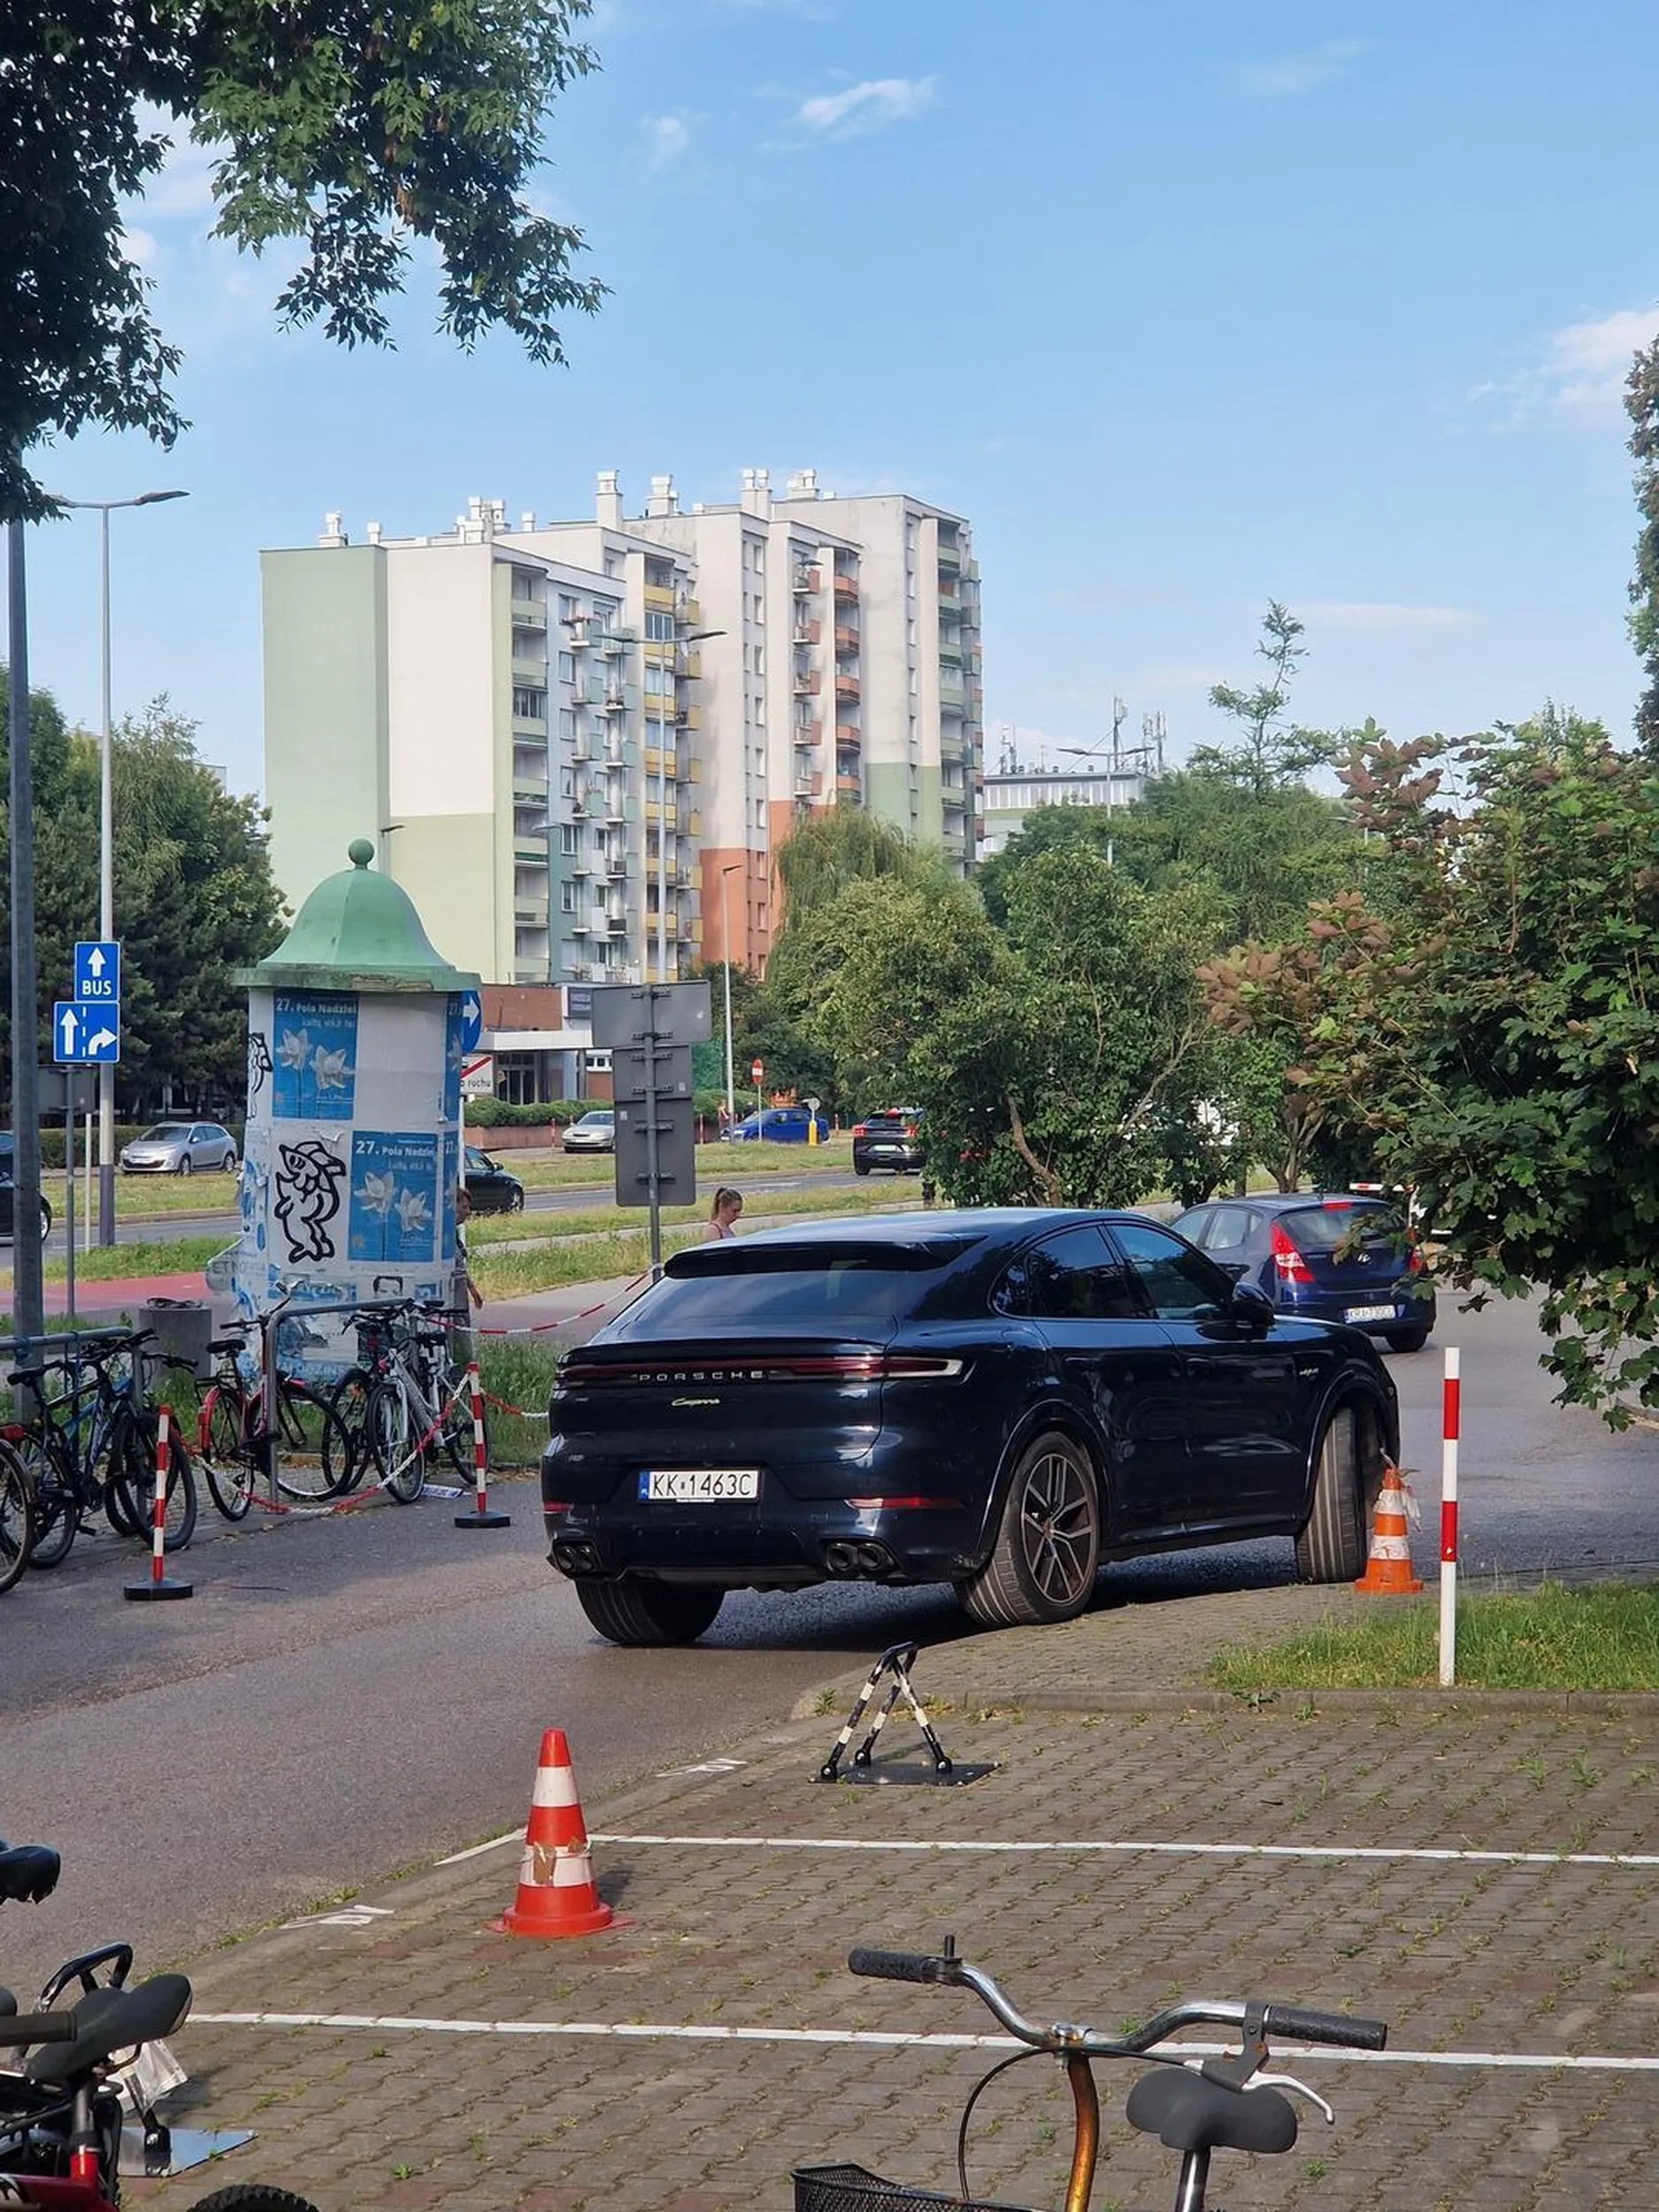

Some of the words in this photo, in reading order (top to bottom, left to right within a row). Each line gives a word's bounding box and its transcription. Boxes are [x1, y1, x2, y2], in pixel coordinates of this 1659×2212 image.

[82, 979, 111, 995] BUS
[275, 997, 296, 1012] 27.
[356, 1141, 380, 1156] 27.
[381, 1145, 403, 1156] Pola
[639, 1371, 764, 1382] PORSCHE
[689, 1473, 751, 1496] 1463C
